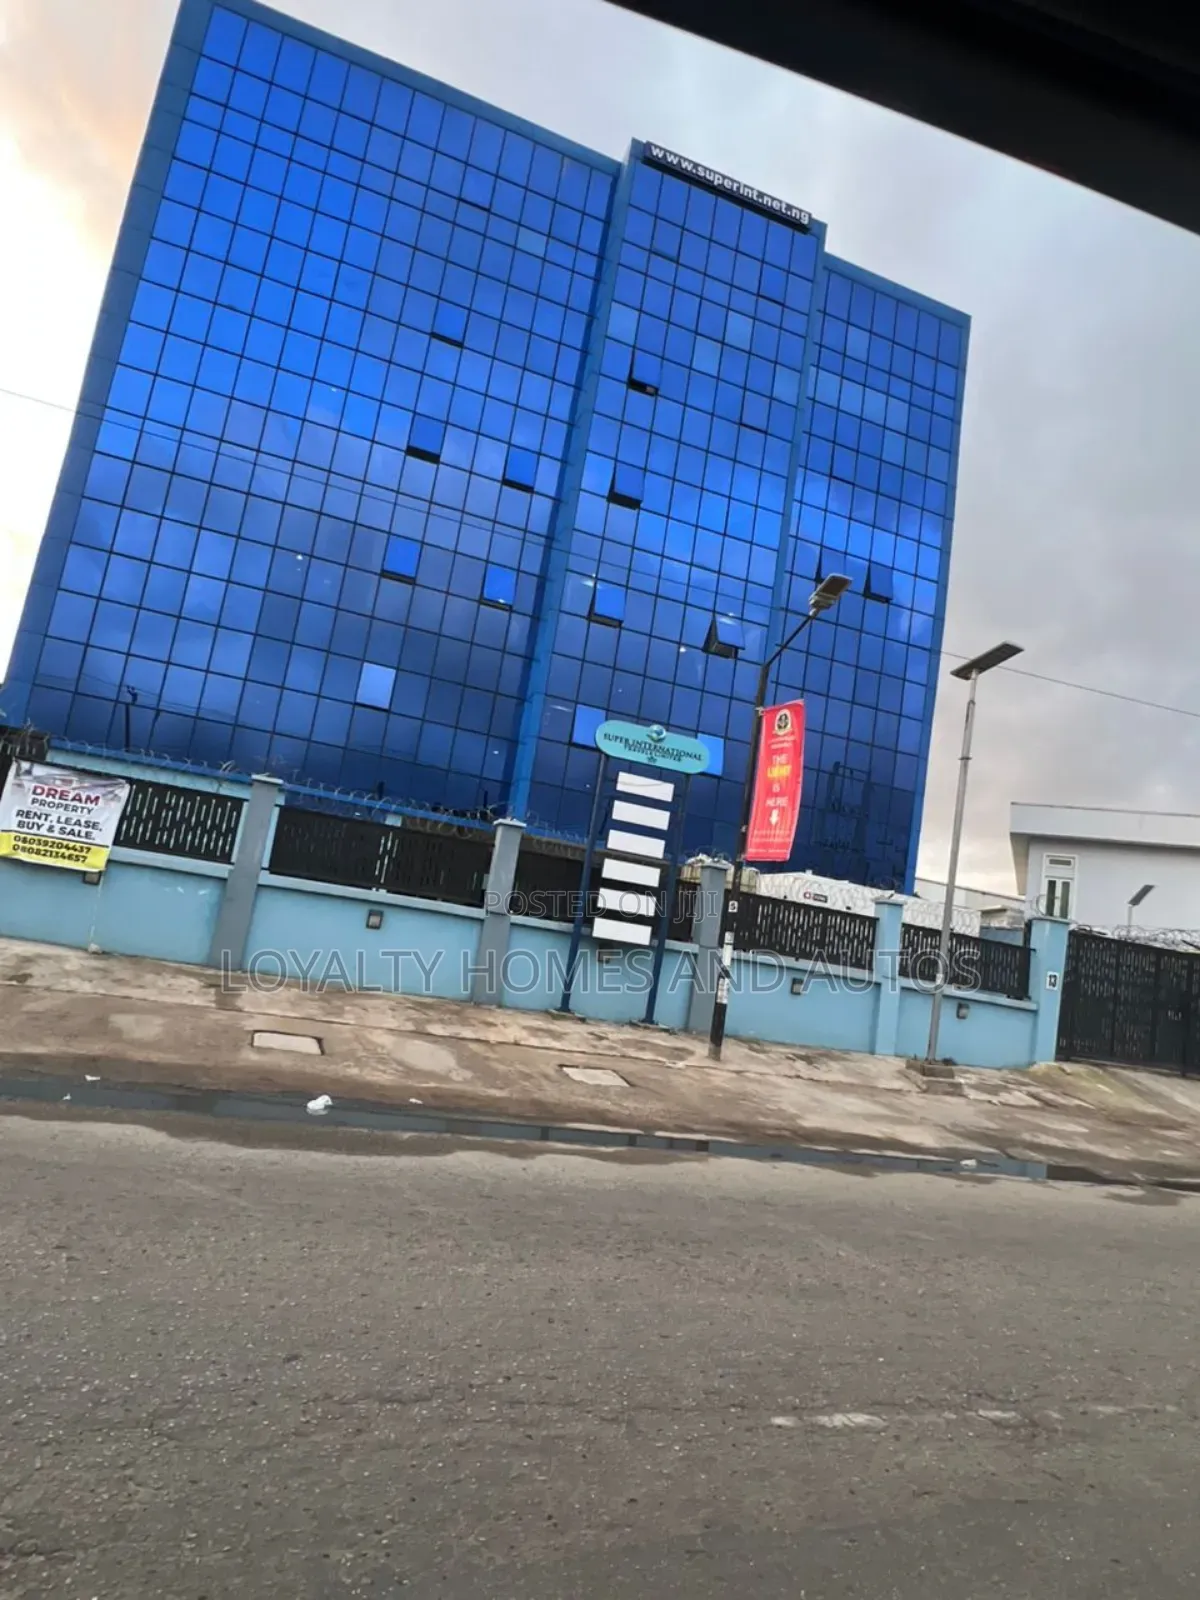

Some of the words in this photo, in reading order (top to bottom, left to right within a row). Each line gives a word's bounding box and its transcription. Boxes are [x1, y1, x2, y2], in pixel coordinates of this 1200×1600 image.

[650, 144, 809, 225] www.superint.net.ng
[603, 733, 632, 746] SUPER
[631, 739, 702, 761] INTERNATIONAL
[31, 797, 94, 815] PROPERTY
[32, 785, 100, 806] DREAM
[17, 820, 44, 832] BUY
[47, 825, 55, 833] &
